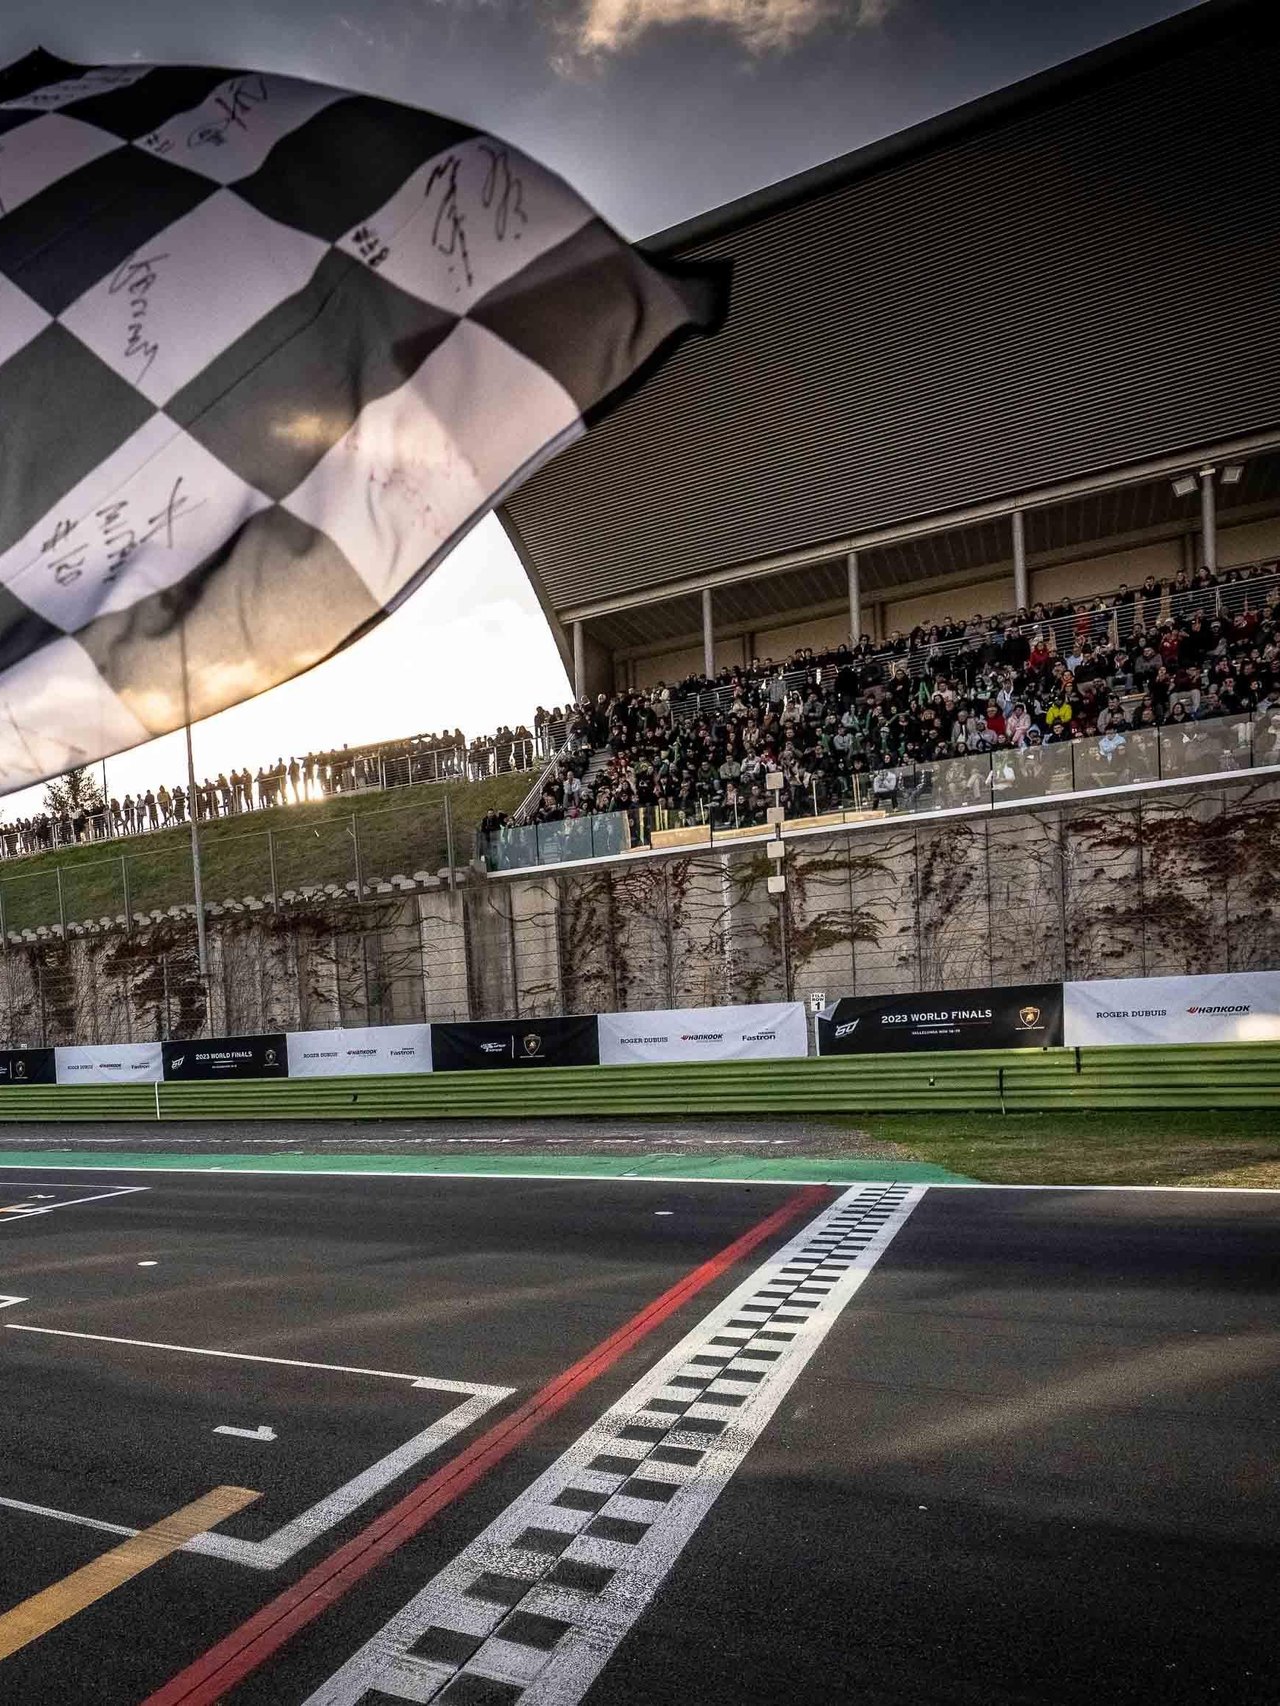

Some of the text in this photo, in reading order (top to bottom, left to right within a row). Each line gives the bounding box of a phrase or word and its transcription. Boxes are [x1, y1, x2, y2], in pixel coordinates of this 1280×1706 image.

[815, 1002, 821, 1010] 1
[881, 1009, 993, 1025] 2023 WORLD FINALS
[1096, 1009, 1167, 1019] ROGER DUBUIS
[742, 1034, 776, 1042] Fastron
[231, 1050, 253, 1058] FINALS
